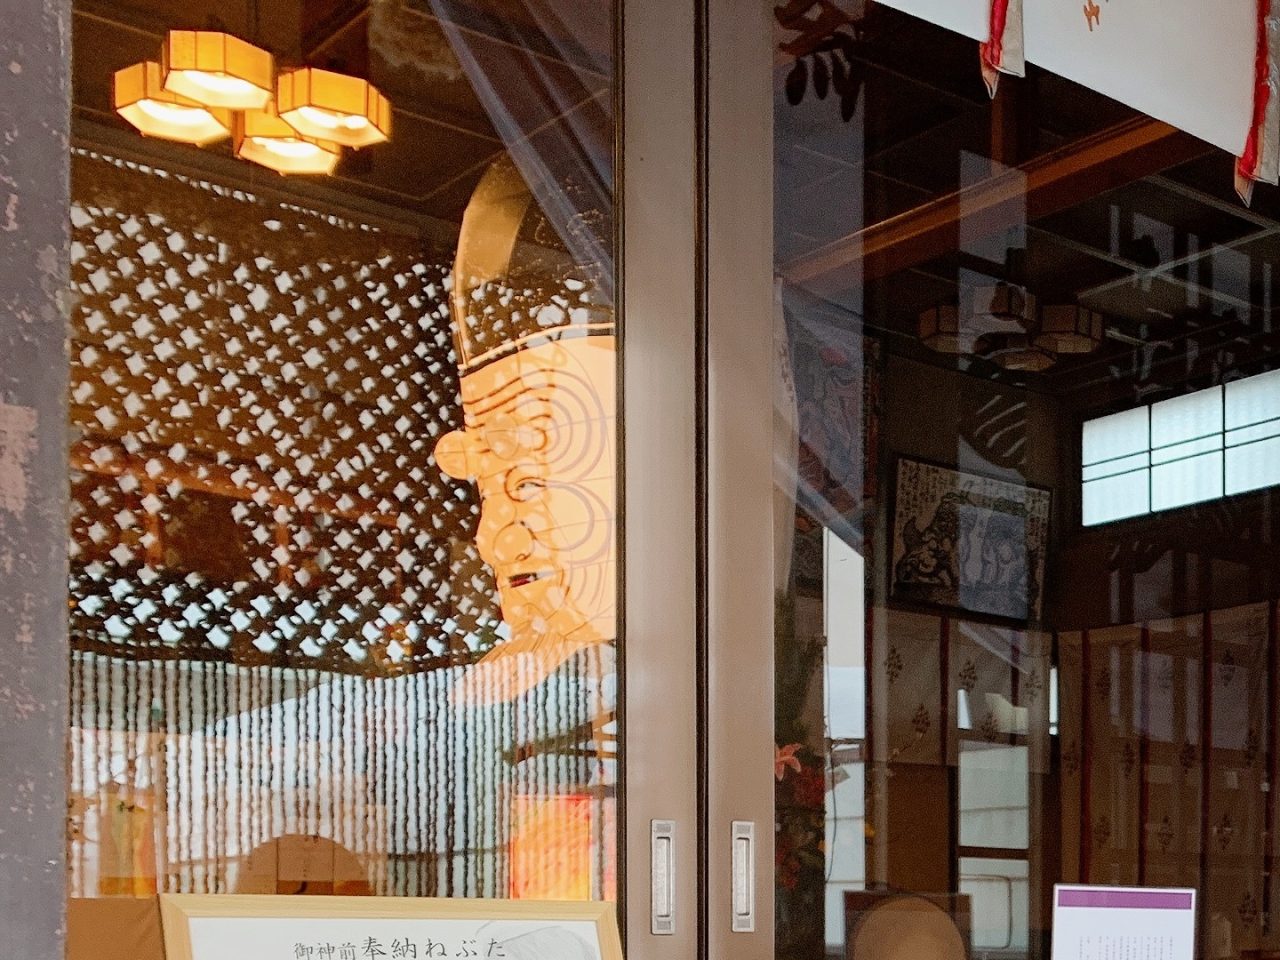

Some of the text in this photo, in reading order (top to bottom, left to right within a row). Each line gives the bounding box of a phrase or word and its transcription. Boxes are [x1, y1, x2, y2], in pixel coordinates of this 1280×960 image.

[294, 936, 505, 960] 御神前奉納ねぶた
